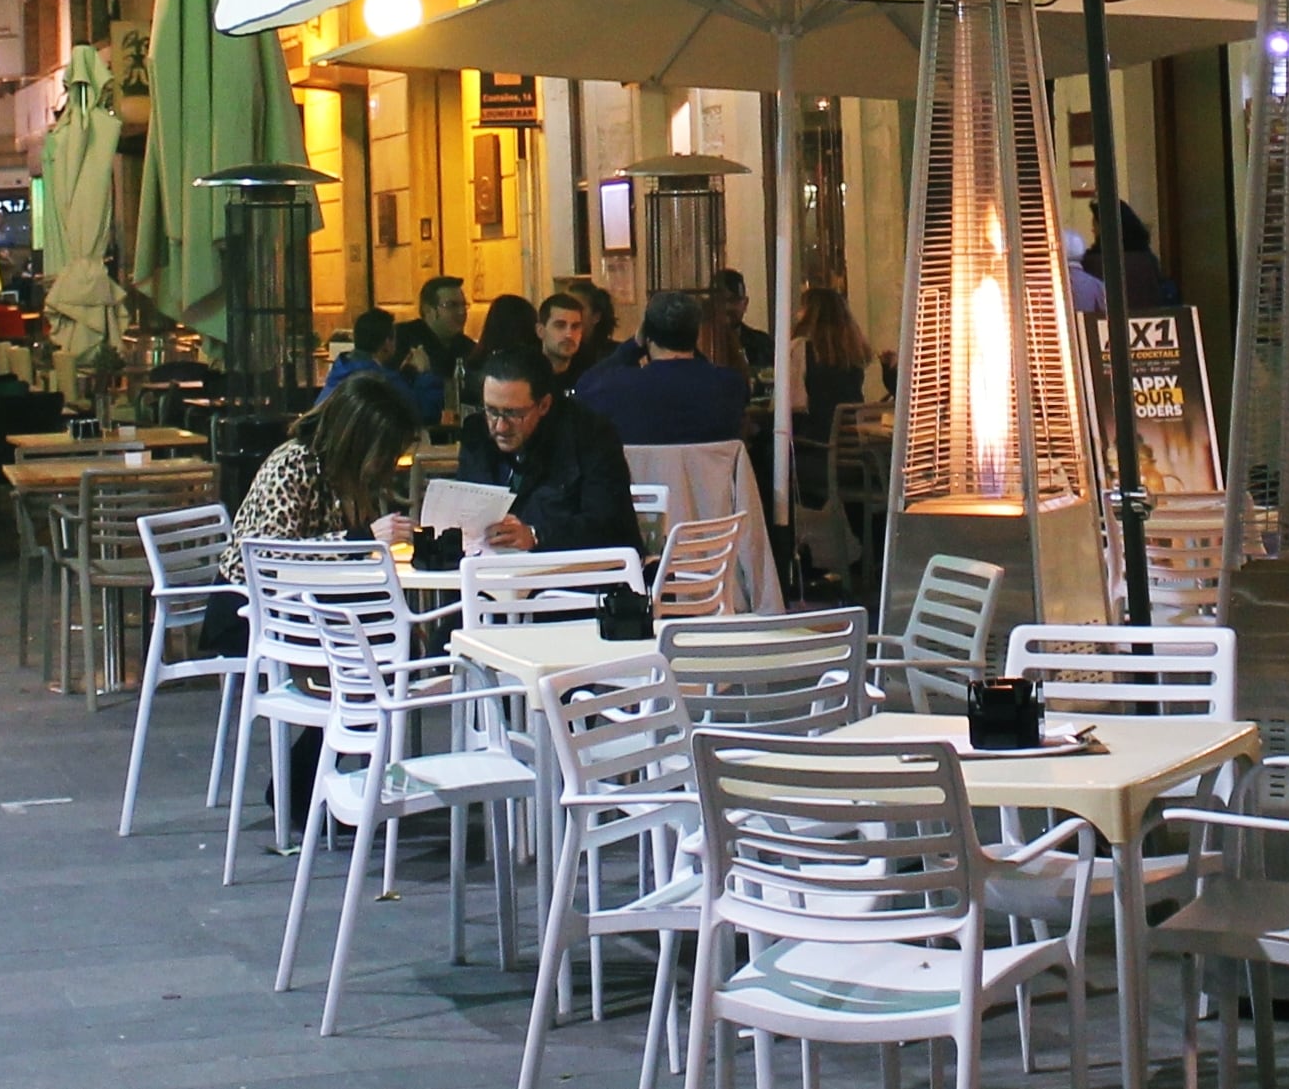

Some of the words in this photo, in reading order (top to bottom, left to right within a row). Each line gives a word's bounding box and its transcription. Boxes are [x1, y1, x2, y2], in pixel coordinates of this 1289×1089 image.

[1132, 375, 1178, 392] APPY
[1134, 390, 1174, 407] OUR
[1135, 404, 1183, 418] ODERS
